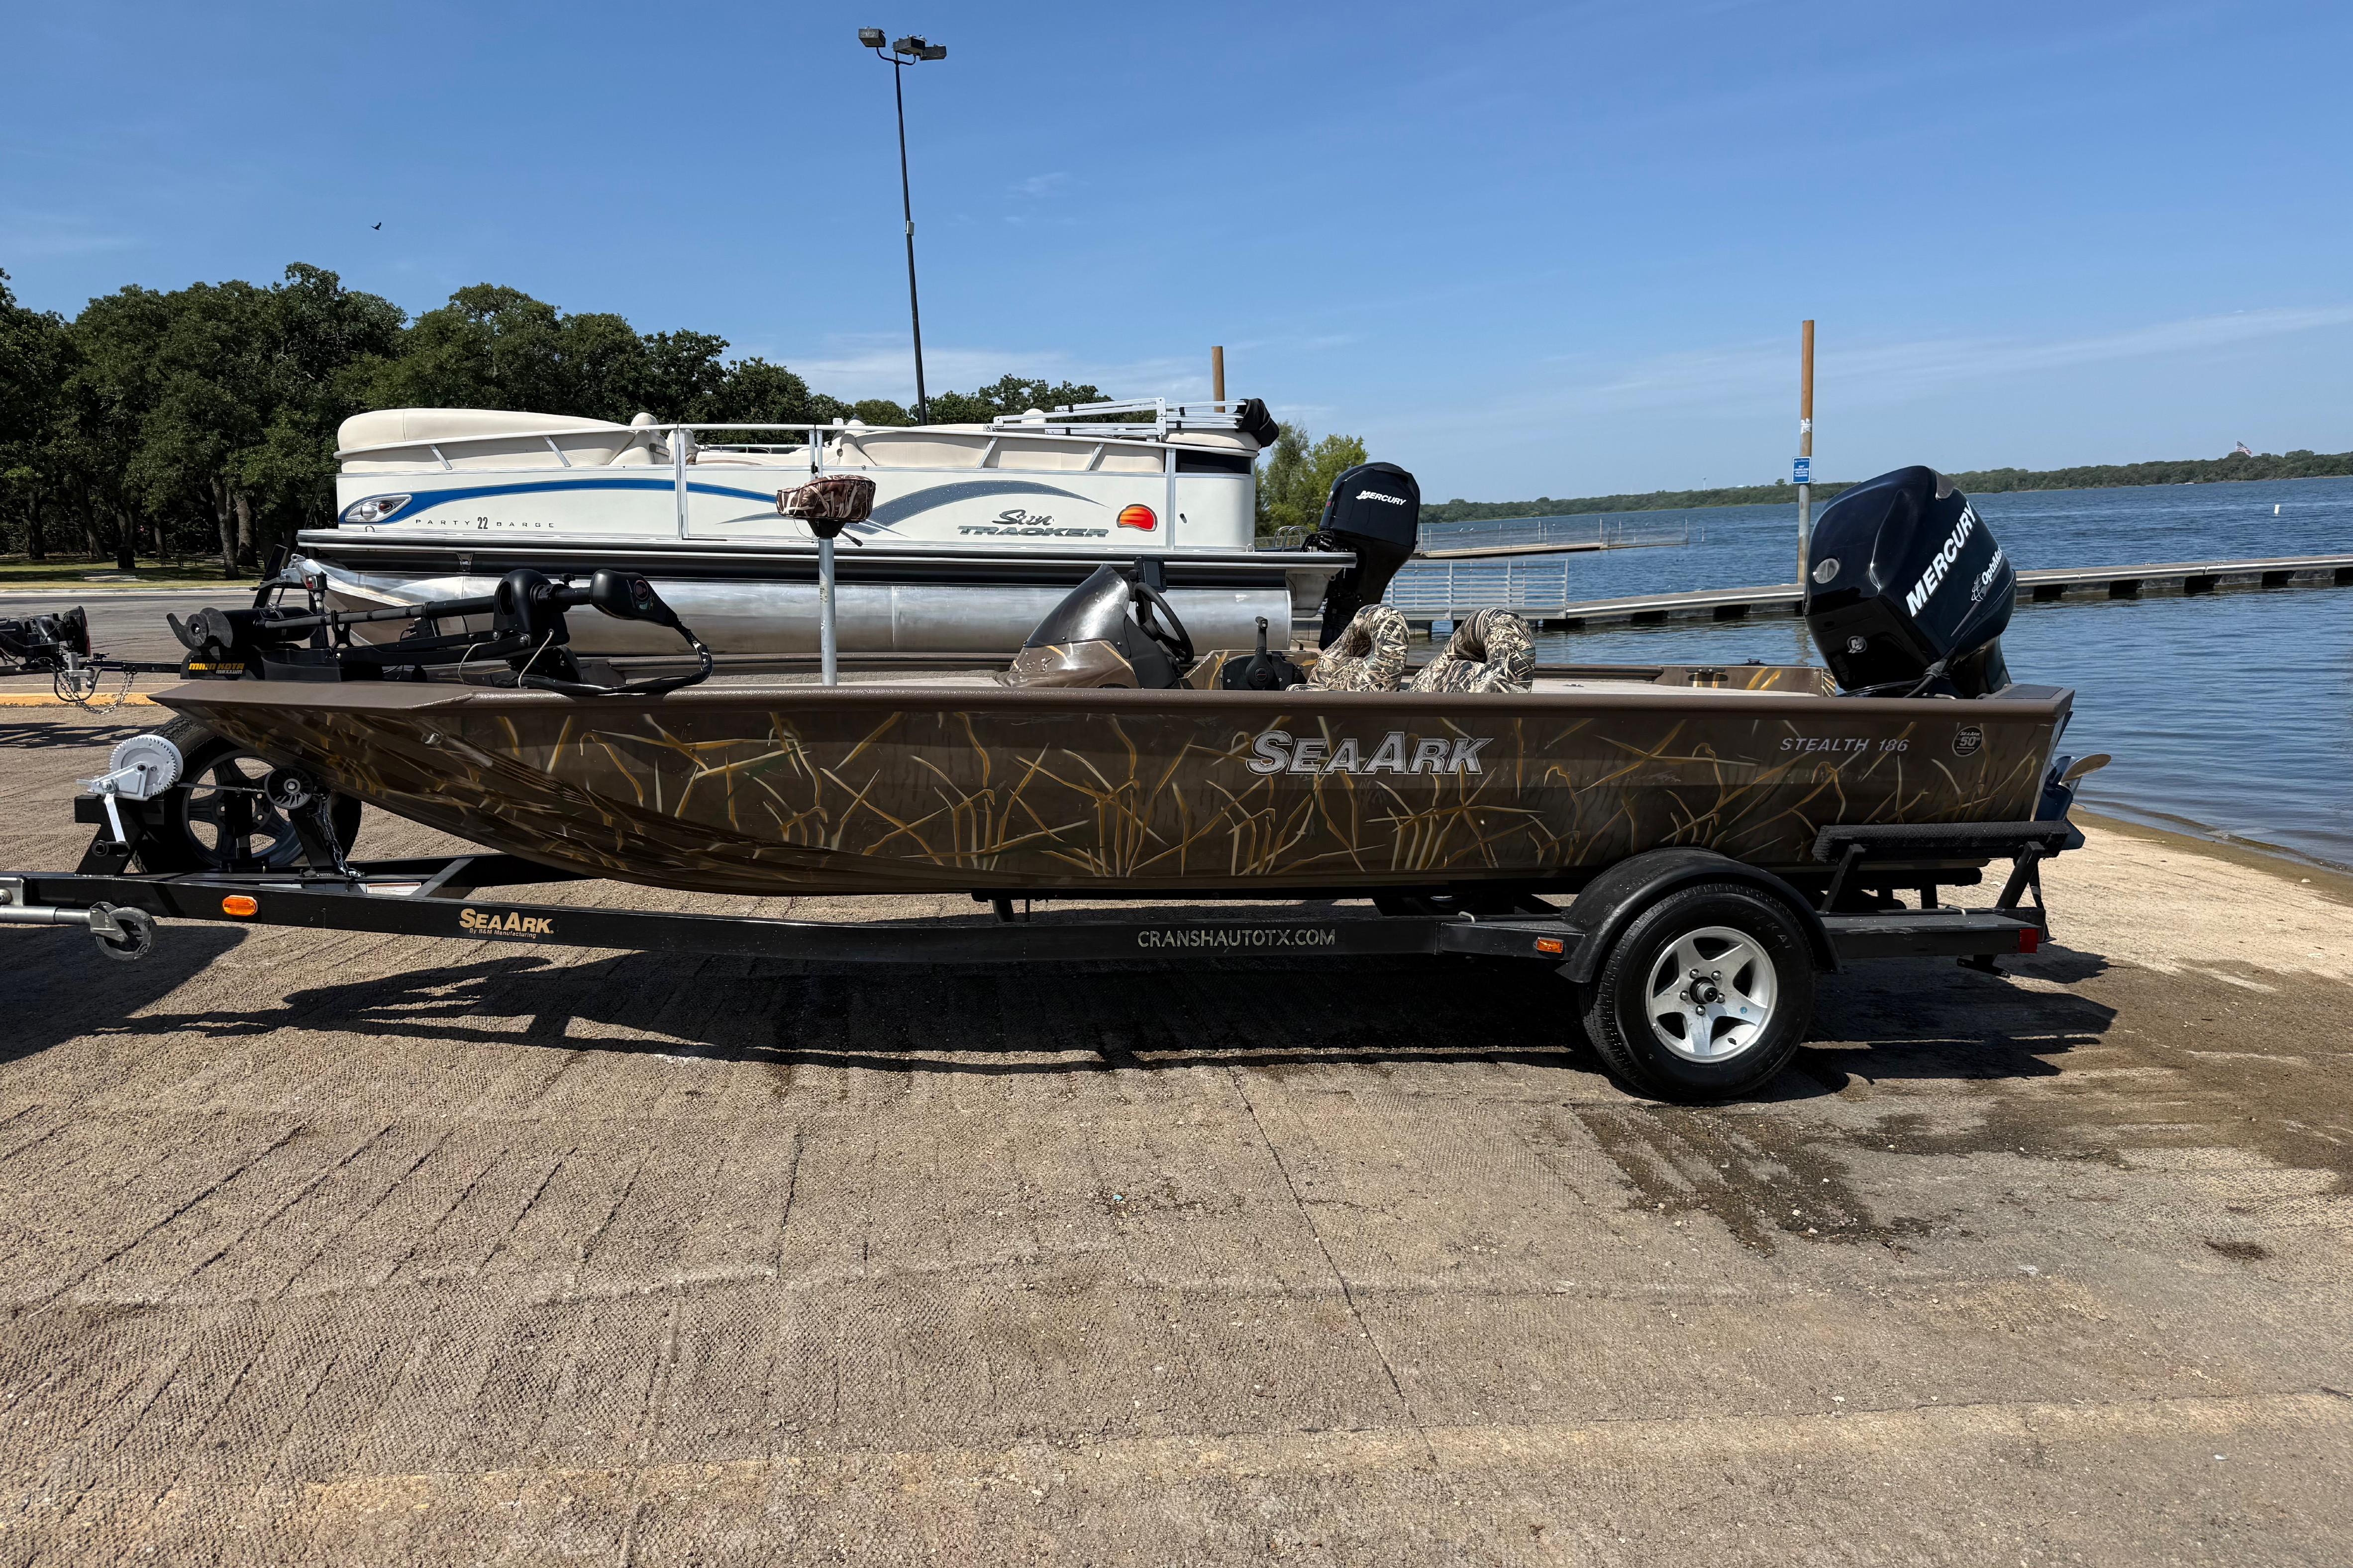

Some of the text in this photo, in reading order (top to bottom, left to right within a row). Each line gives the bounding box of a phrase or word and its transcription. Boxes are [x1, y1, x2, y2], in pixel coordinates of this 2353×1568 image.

[1355, 490, 1407, 505] MERCURY
[477, 516, 488, 529] 22
[992, 509, 1054, 525] Sun
[957, 525, 1109, 538] TRACKER
[1906, 501, 1976, 617] MERCURY
[1780, 738, 1910, 751] STEALTH 186
[1959, 736, 1976, 747] 50
[494, 930, 536, 939] Manufacturing
[1137, 929, 1335, 947] CRANSHAUTOTX.COM
